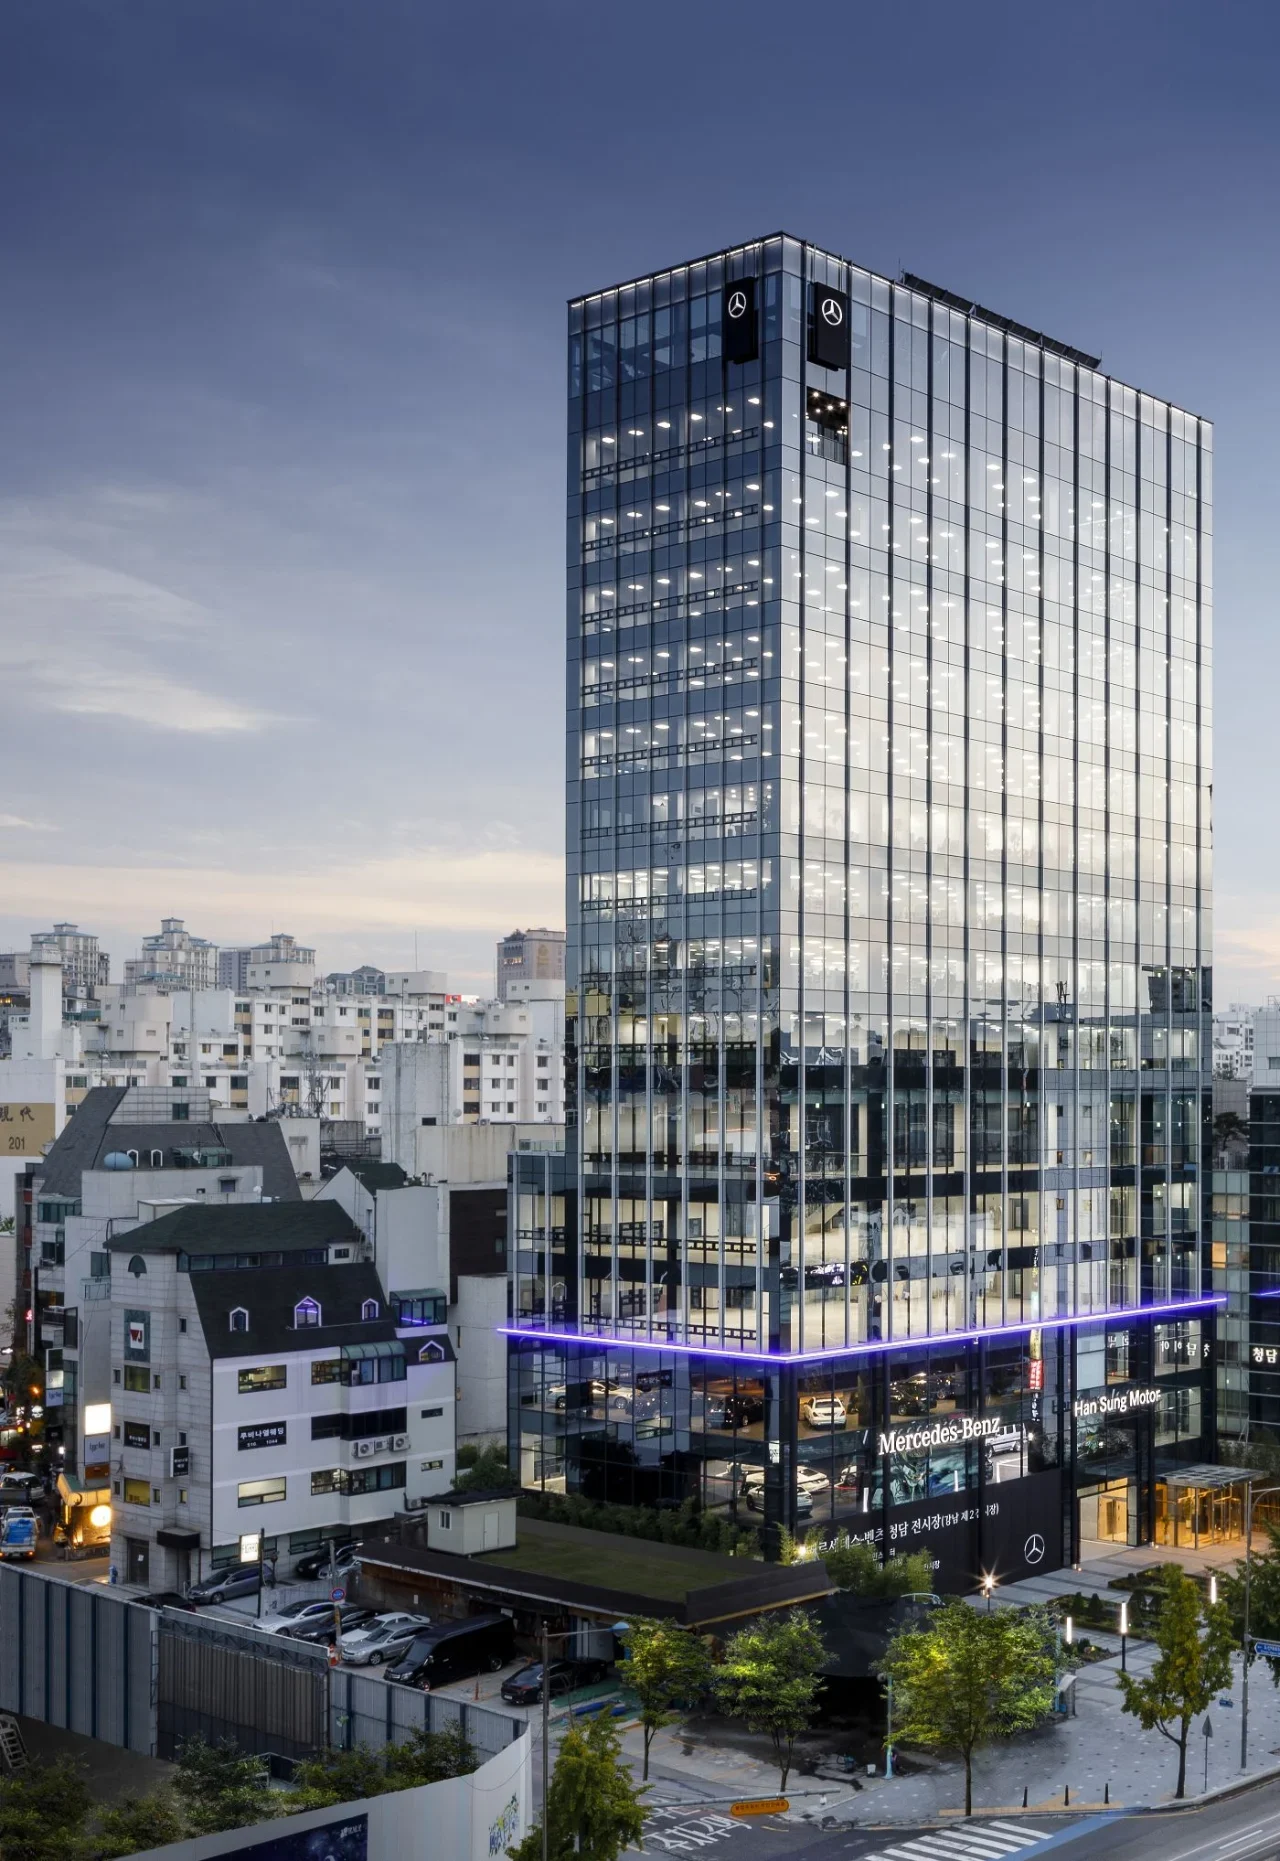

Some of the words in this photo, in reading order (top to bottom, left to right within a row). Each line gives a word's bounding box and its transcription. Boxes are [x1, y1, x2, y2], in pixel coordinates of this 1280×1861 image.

[8, 1136, 25, 1150] 201
[1074, 1400, 1097, 1417] Han
[1099, 1395, 1127, 1412] Sung
[1129, 1389, 1161, 1407] Motor
[878, 1416, 1000, 1456] Mercedes-Benz
[889, 1523, 909, 1541] 청담
